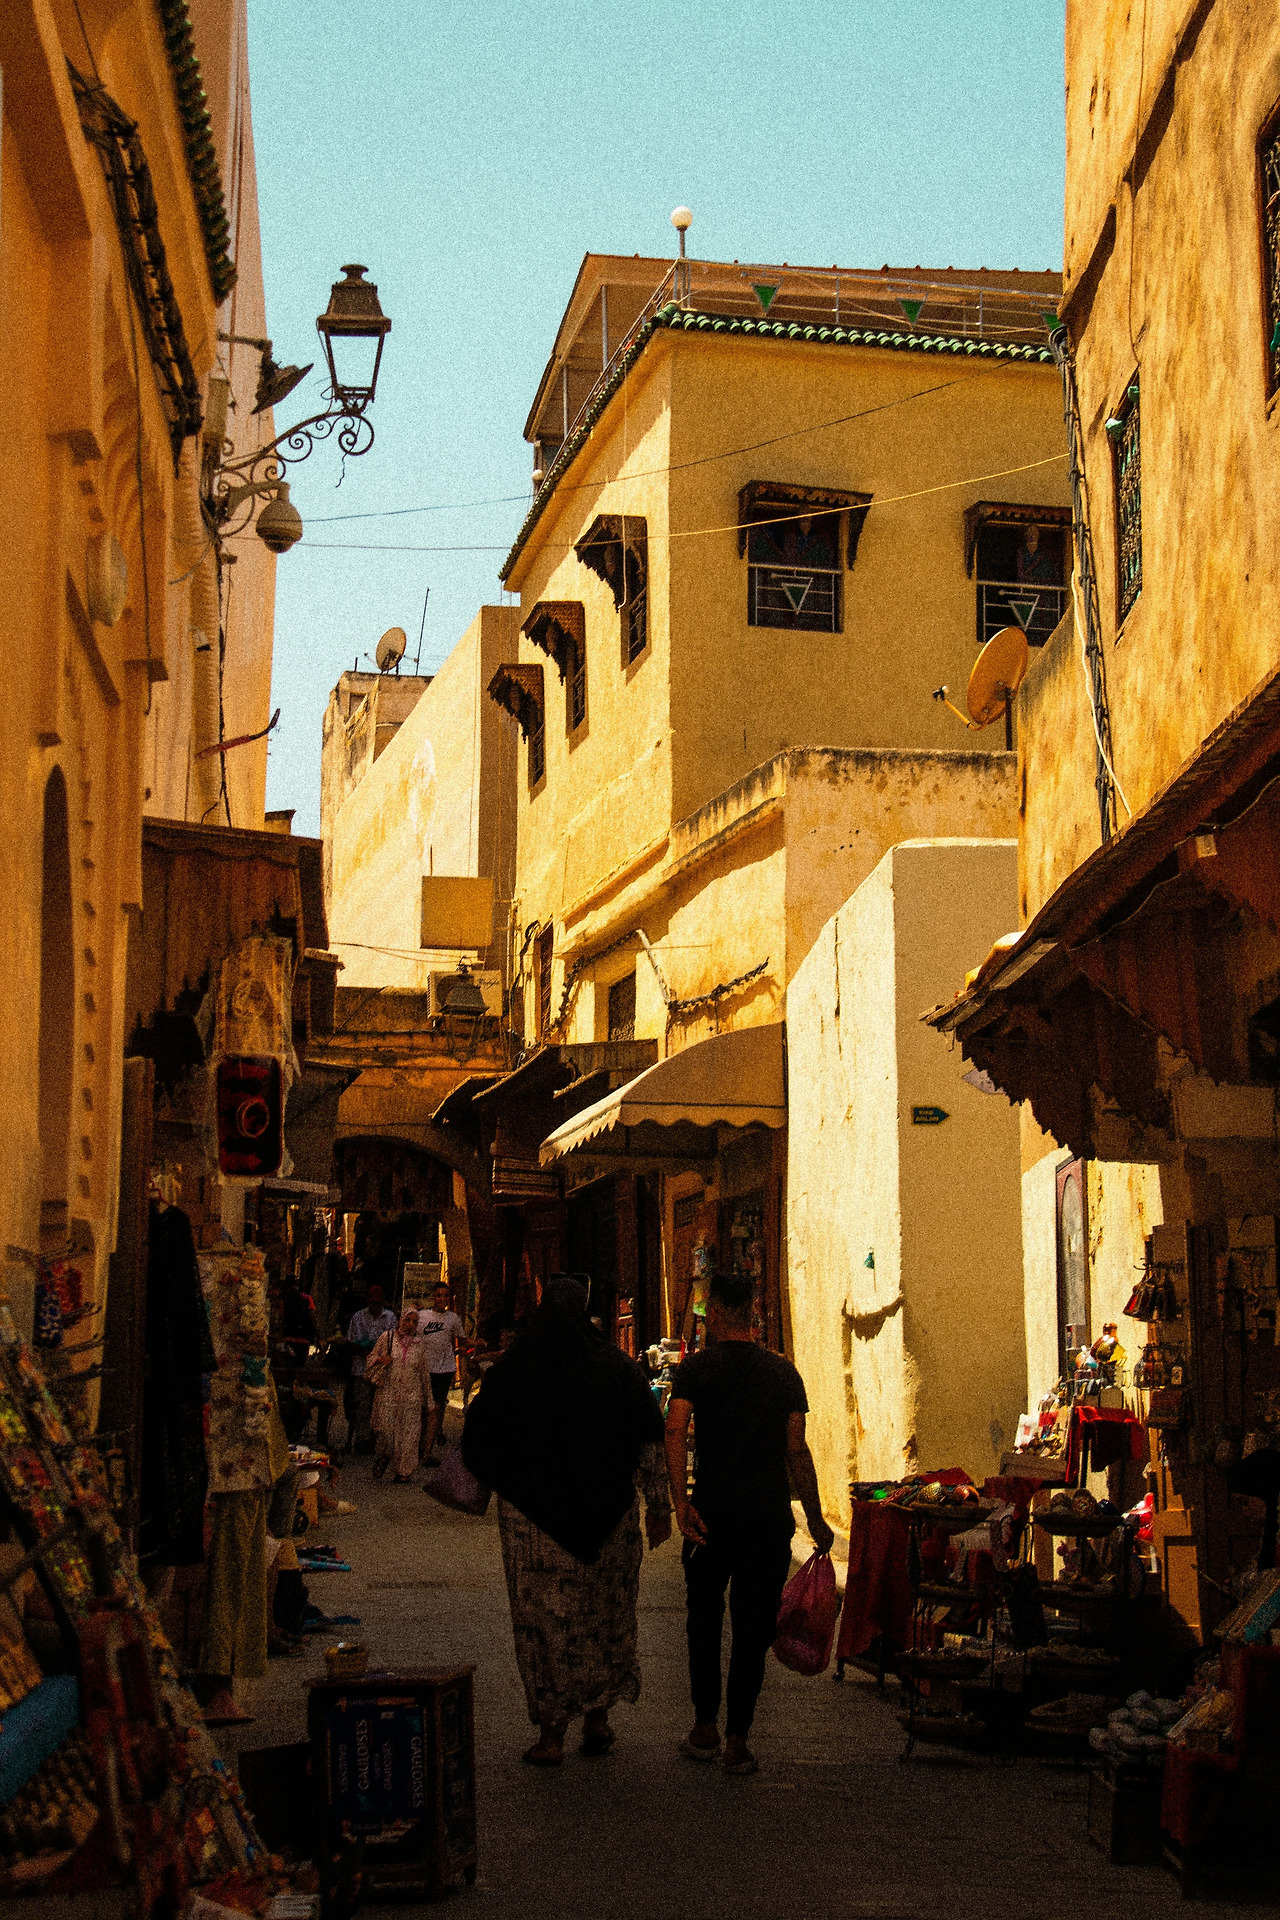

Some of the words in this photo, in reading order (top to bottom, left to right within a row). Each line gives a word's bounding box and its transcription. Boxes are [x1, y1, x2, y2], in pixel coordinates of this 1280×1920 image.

[427, 1321, 444, 1330] NIKE
[356, 1718, 370, 1791] GAULOISES
[410, 1735, 424, 1809] GAULOISES
